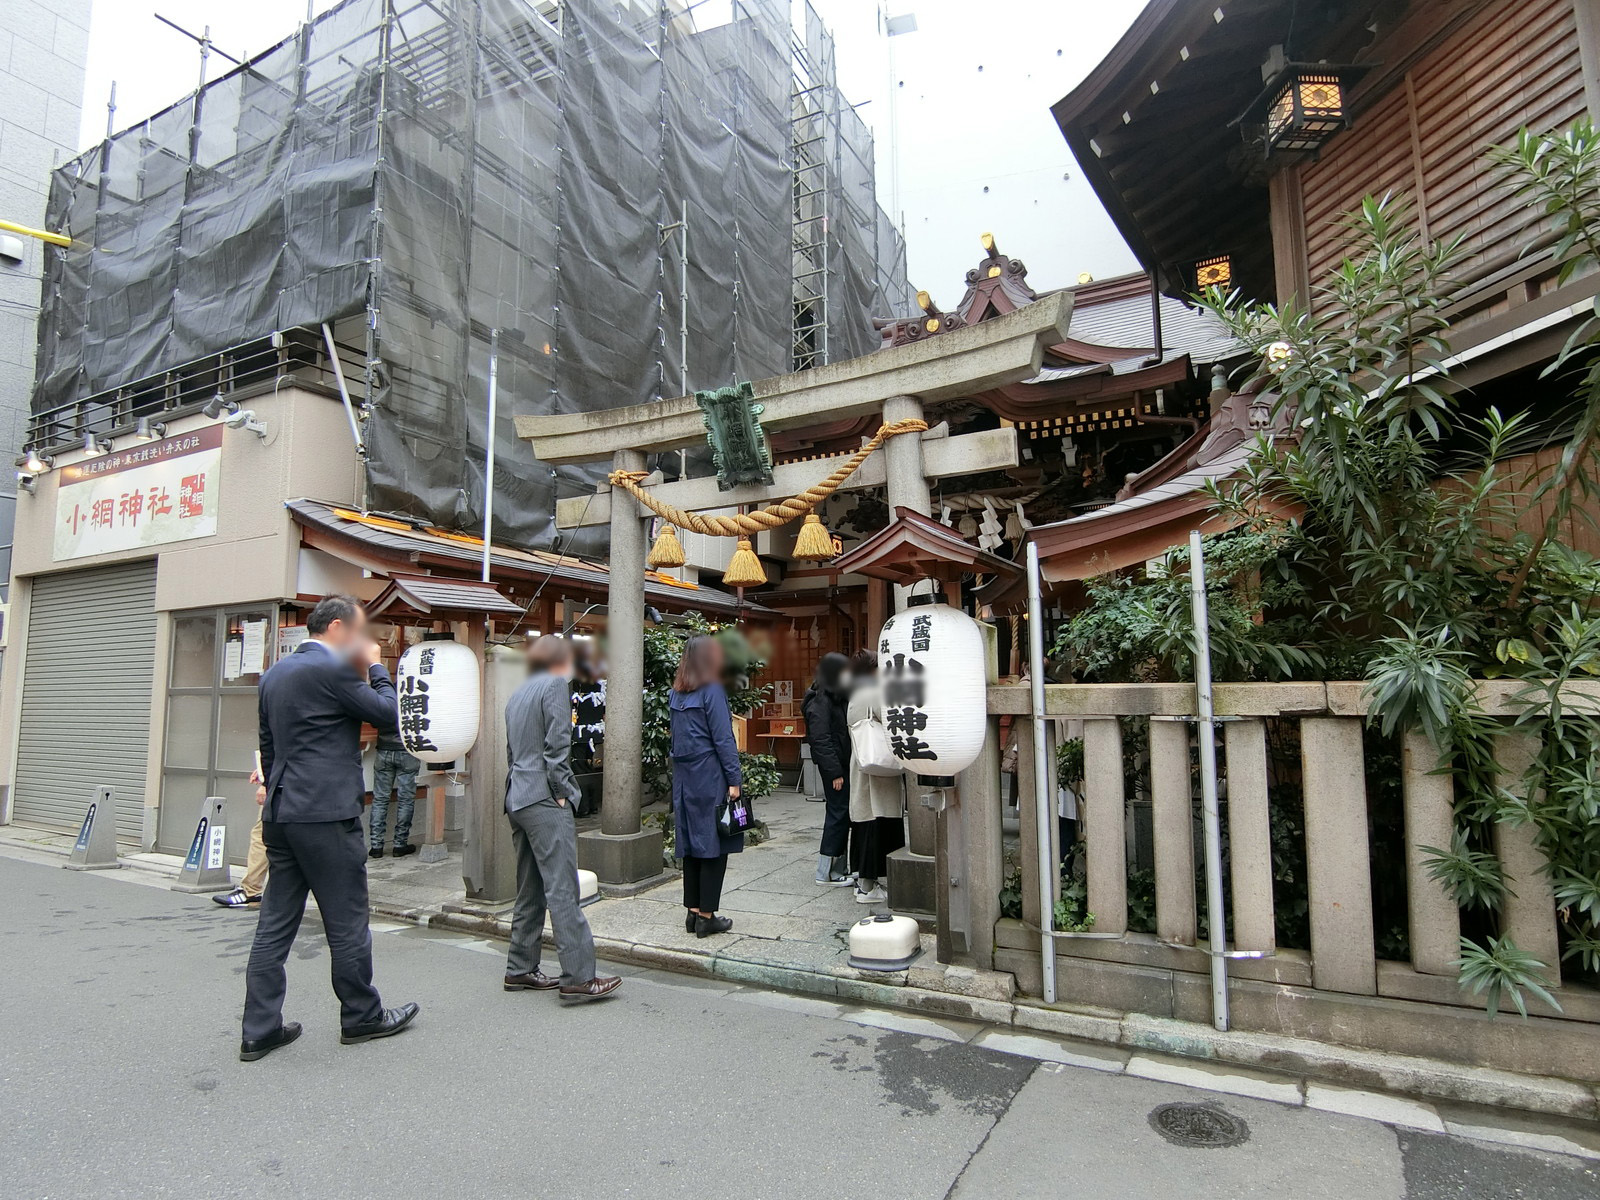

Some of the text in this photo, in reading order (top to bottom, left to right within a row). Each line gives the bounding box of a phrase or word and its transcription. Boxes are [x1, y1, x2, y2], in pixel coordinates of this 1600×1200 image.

[66, 486, 173, 535] 小網神社
[911, 614, 932, 653] 武蔵国
[419, 647, 436, 676] 武蔵国
[399, 675, 438, 753] 小網神社
[212, 828, 222, 866] 小網神社
